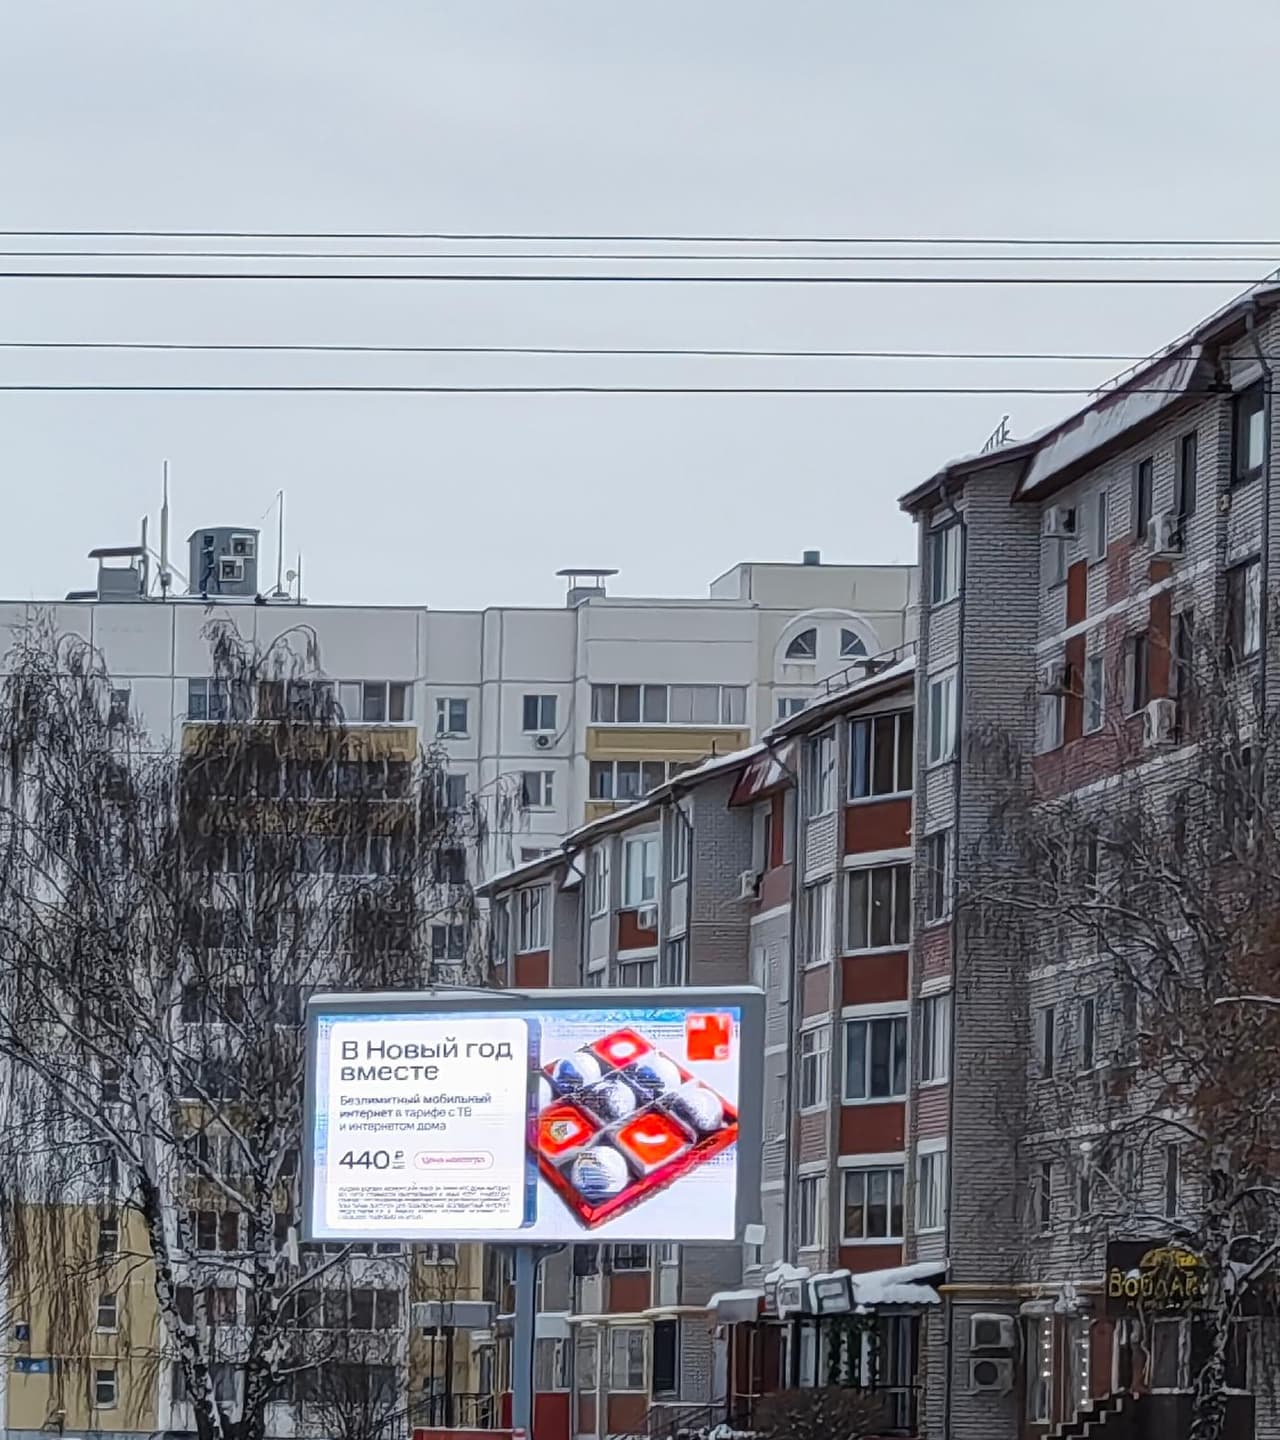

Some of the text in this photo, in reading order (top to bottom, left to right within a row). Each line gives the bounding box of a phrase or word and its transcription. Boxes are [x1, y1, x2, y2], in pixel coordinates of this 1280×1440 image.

[341, 1036, 513, 1061] В Новый год
[340, 1064, 439, 1081] вместе
[340, 1092, 492, 1105] Безлимитный мобильный
[339, 1108, 392, 1119] интернет
[405, 1106, 446, 1118] тарифе
[458, 1106, 472, 1117] ТВ
[339, 1122, 447, 1132] и интернетом дома
[338, 1150, 390, 1170] 440
